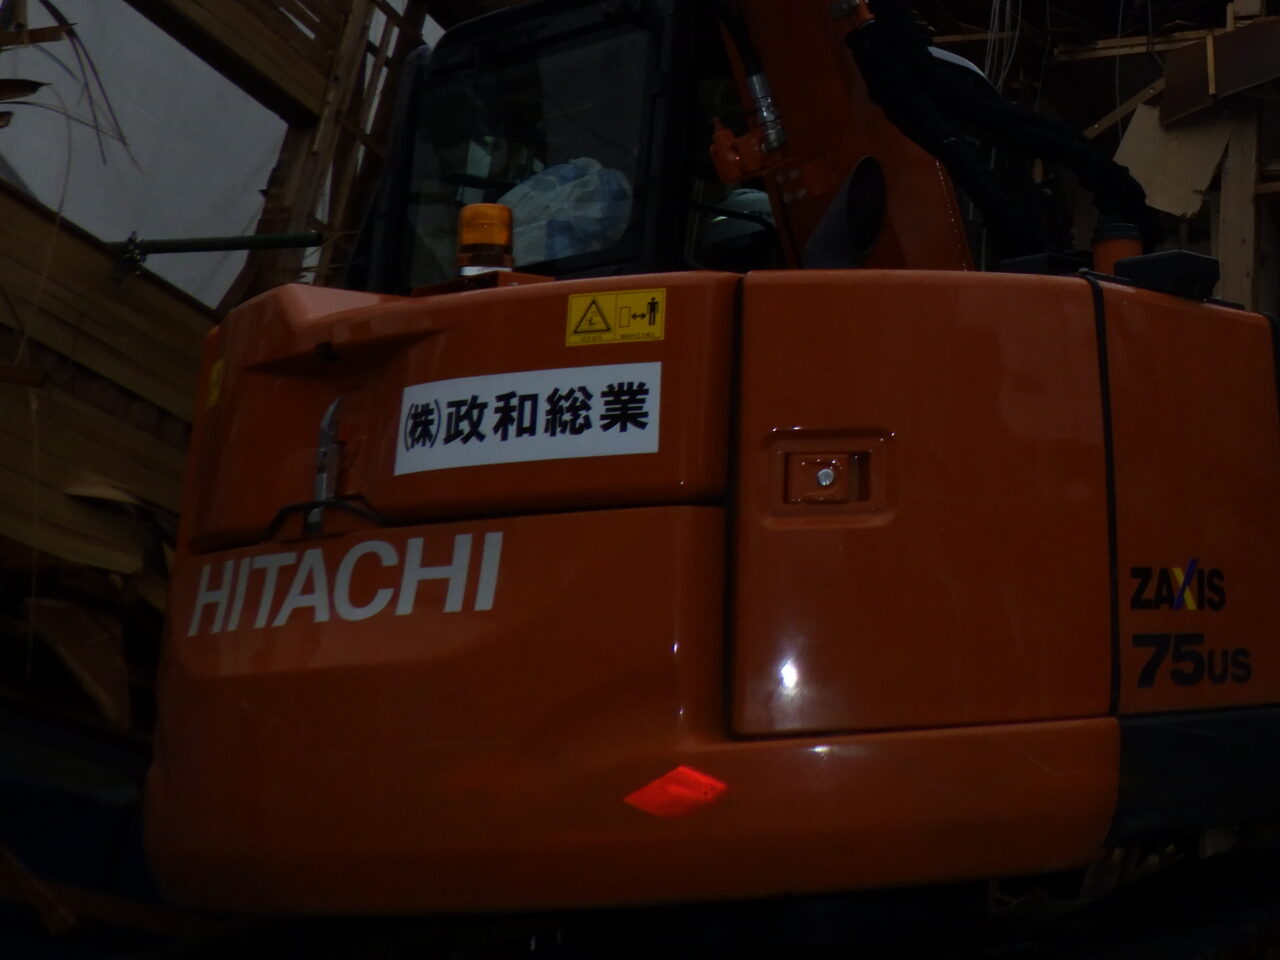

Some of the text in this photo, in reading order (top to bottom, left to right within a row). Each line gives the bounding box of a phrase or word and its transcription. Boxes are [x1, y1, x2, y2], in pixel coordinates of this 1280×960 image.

[404, 382, 649, 451] (株)政和総業
[187, 531, 504, 637] HITACHI
[1130, 557, 1226, 611] ZAXIS
